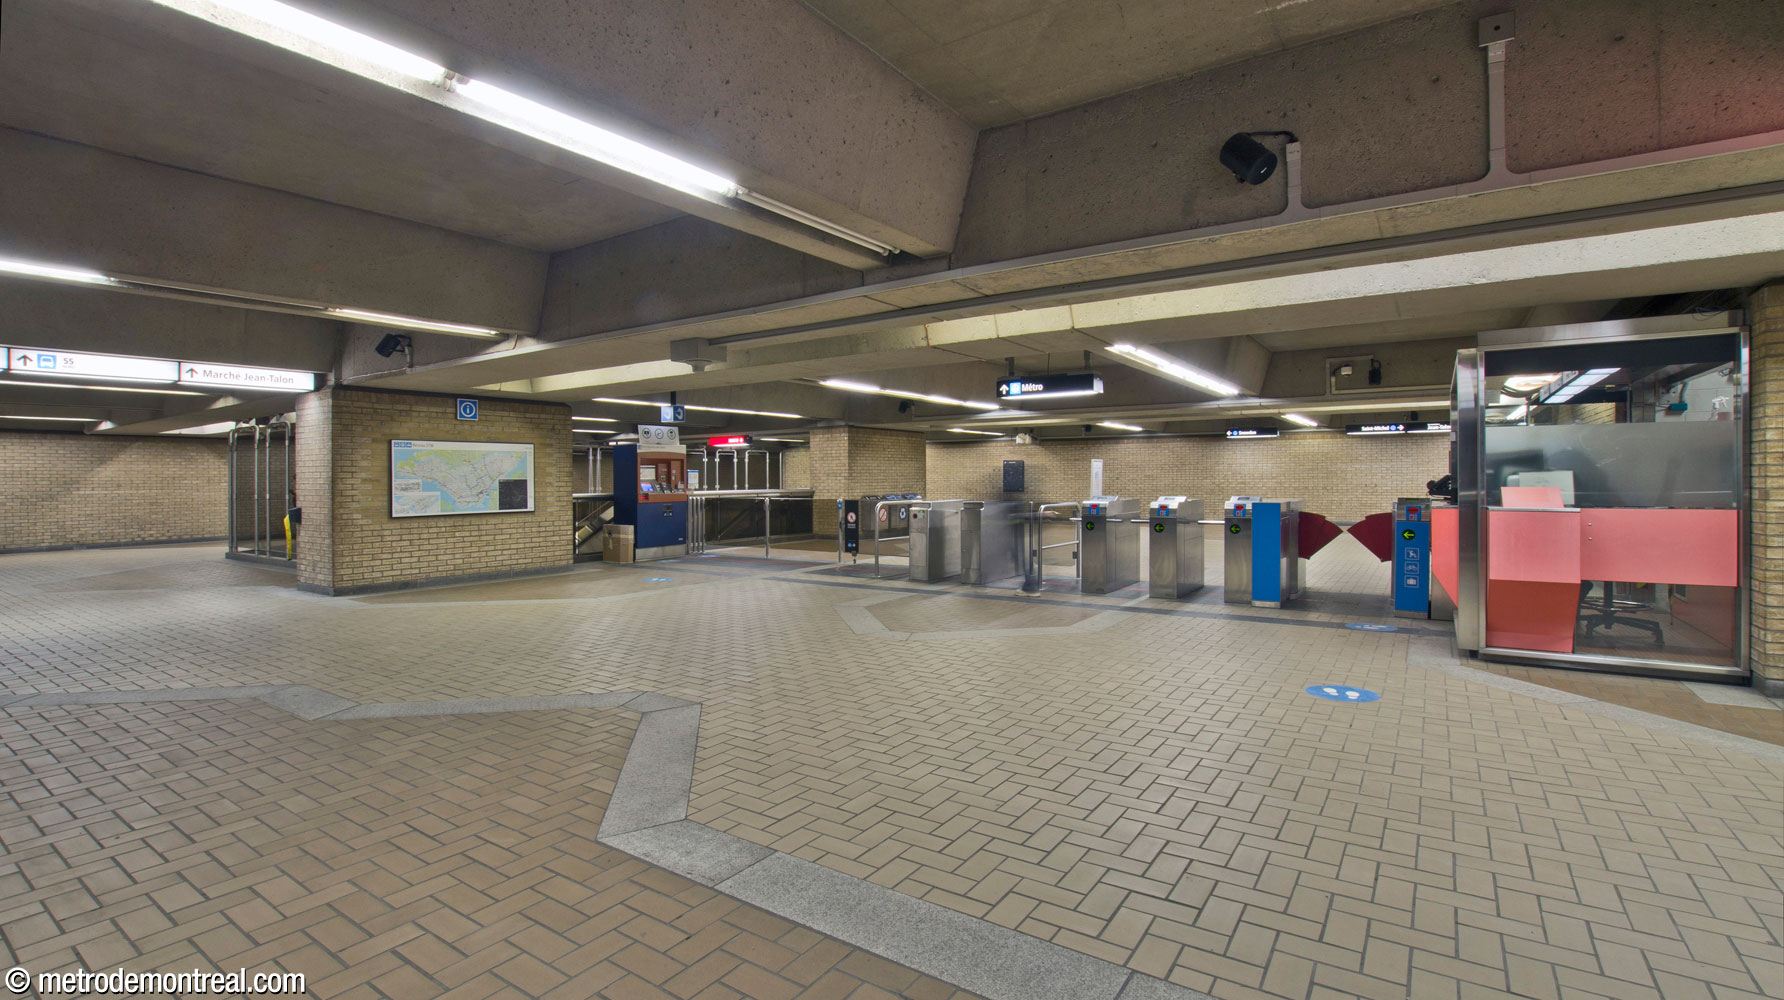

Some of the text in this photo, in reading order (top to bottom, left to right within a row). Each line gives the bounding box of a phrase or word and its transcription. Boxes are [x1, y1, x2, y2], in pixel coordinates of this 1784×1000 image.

[202, 369, 294, 384] Marché Jean-Talon
[1021, 383, 1043, 392] Métro
